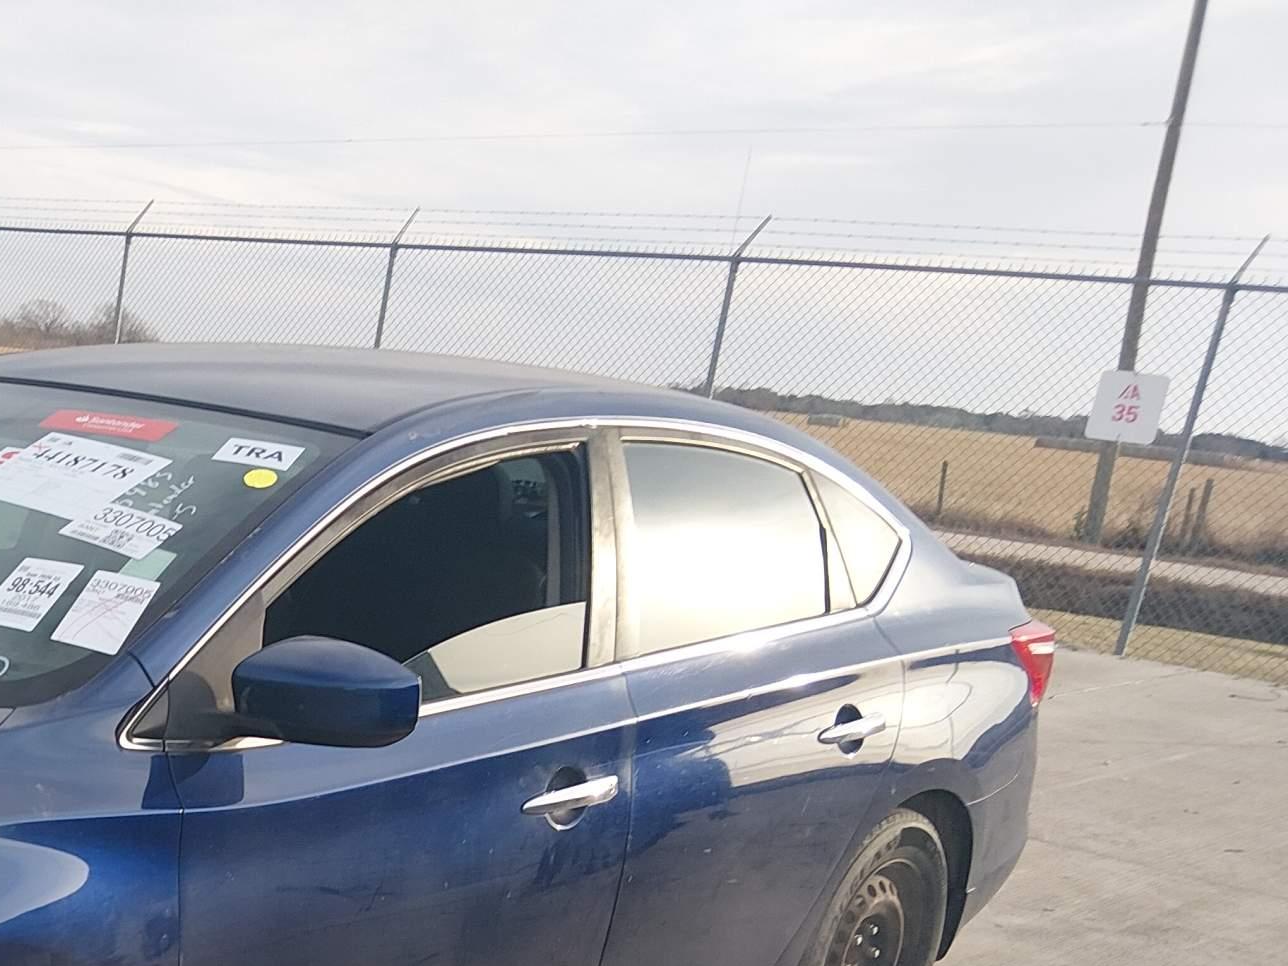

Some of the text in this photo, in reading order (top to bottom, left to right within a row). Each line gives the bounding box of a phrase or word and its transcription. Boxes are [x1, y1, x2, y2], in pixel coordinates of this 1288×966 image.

[1112, 403, 1140, 423] 35
[33, 448, 135, 480] 44187178
[232, 444, 283, 462] TRA
[93, 507, 177, 542] 3307005
[6, 576, 61, 599] 98:544
